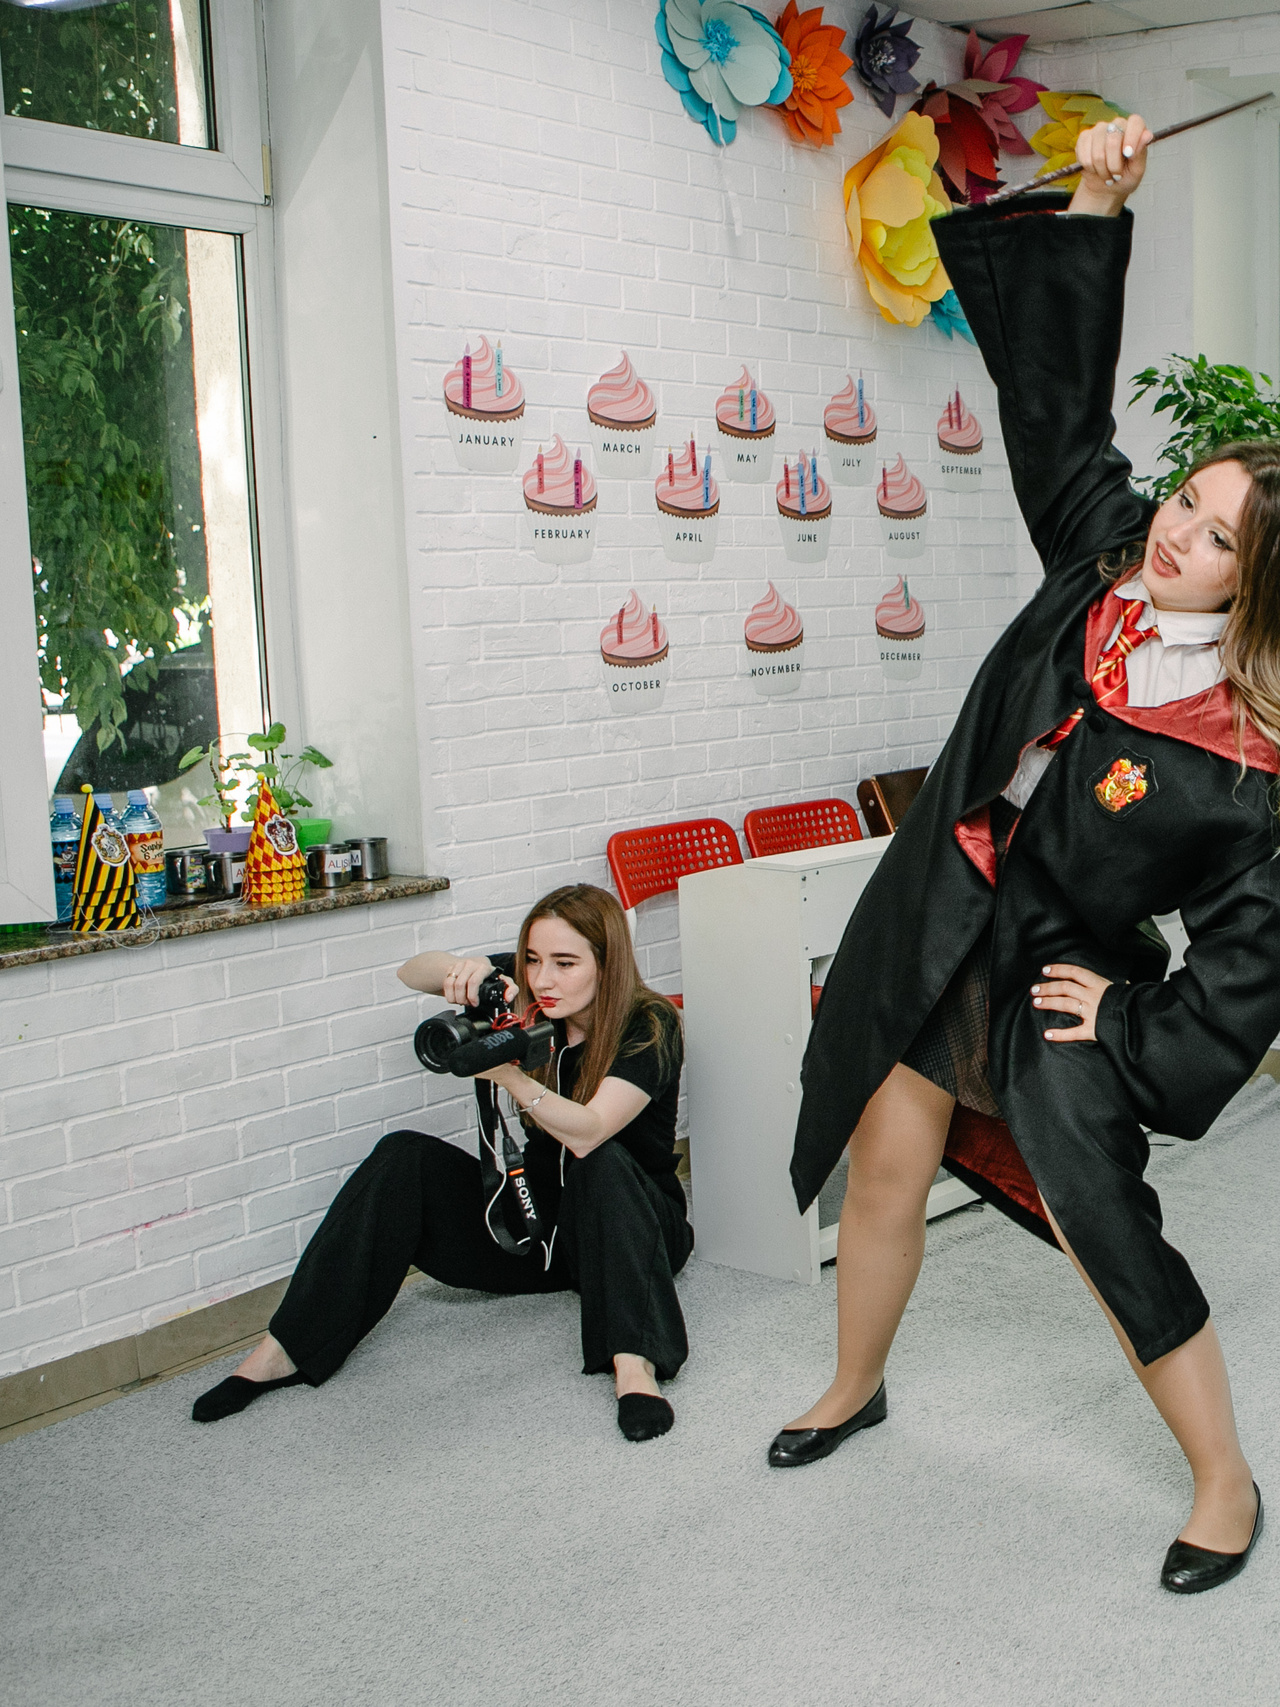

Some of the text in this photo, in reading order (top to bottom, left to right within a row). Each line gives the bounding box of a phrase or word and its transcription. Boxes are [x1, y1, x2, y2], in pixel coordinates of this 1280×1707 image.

[458, 433, 515, 448] JANUARY
[602, 442, 641, 454] MARCH
[736, 453, 758, 464] MAY
[842, 457, 862, 468] JULY
[941, 465, 982, 476] SEPTEMBER
[534, 528, 591, 540] FEBRUARY
[675, 532, 703, 543] APRIL
[797, 533, 817, 543] JUNE
[888, 530, 921, 541] AUGUST
[880, 651, 922, 661] DECEMBER
[750, 662, 802, 678] NOVEMBER
[612, 678, 662, 693] OCTOBER
[513, 1175, 537, 1220] SONY
